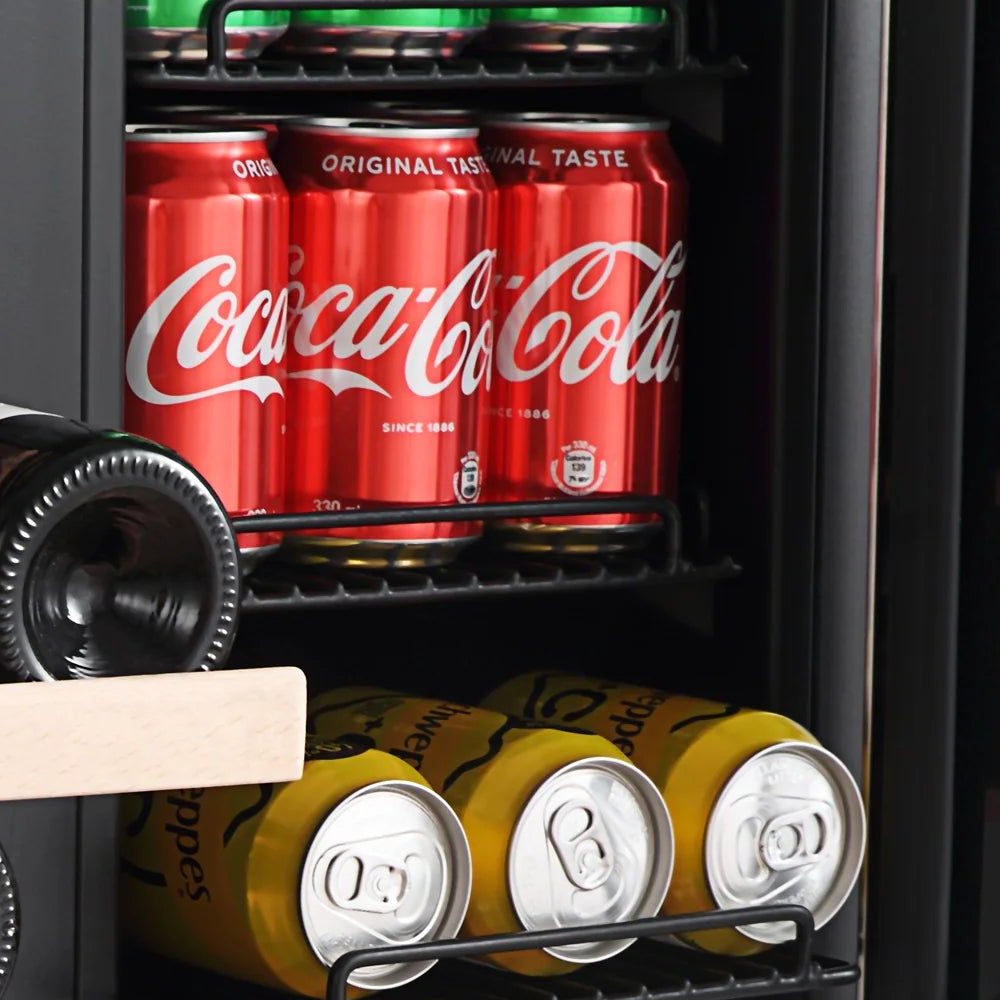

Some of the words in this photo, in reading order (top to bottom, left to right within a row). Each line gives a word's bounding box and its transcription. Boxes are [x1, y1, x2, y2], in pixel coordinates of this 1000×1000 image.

[322, 154, 443, 176] ORIGINAL
[552, 149, 629, 168] TASTE
[381, 422, 424, 433] SINCE
[427, 422, 455, 433] 1886
